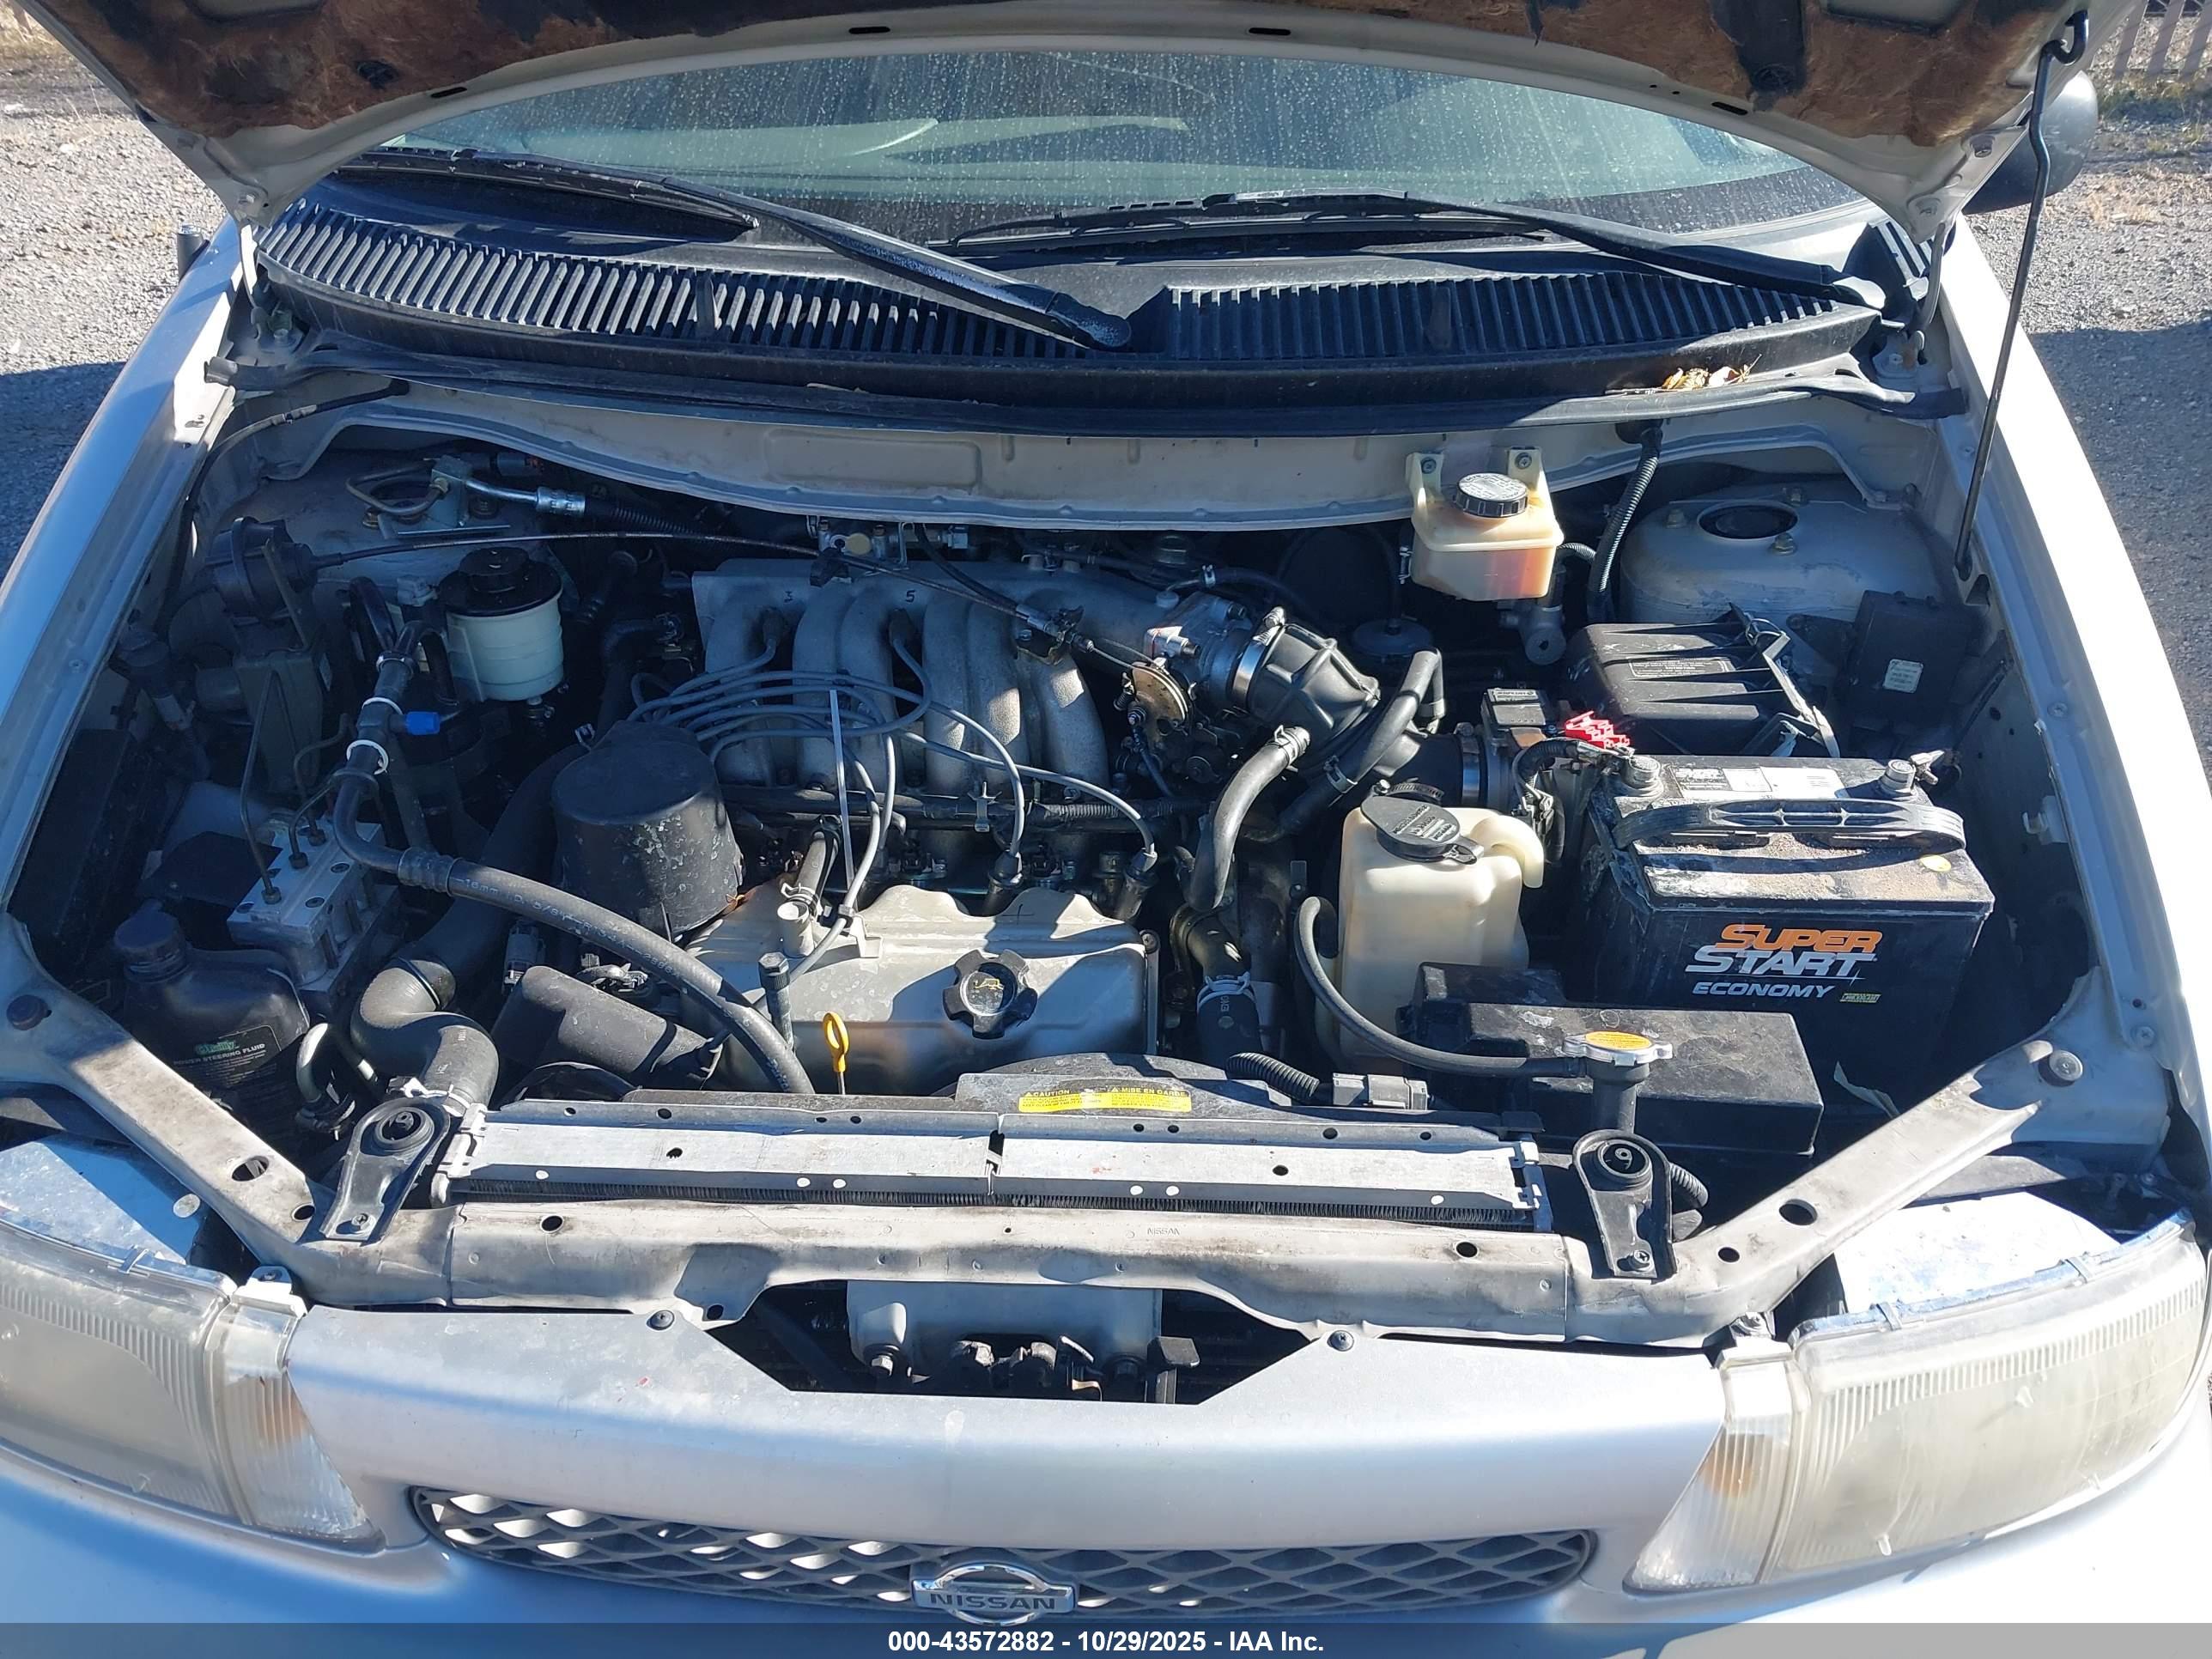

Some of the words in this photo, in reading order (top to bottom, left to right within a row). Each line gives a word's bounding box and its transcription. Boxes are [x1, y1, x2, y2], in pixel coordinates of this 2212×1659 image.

[905, 590, 915, 603] 5
[1715, 924, 1883, 952] SUPER
[1685, 945, 1876, 976] START
[1692, 981, 1835, 998] ECONOMY
[203, 1050, 241, 1062] STEERING
[242, 1043, 265, 1054] FLUID
[1033, 1089, 1070, 1097] CAUTION
[1146, 1227, 1181, 1236] NISSAN
[930, 1593, 1055, 1610] NISSAN
